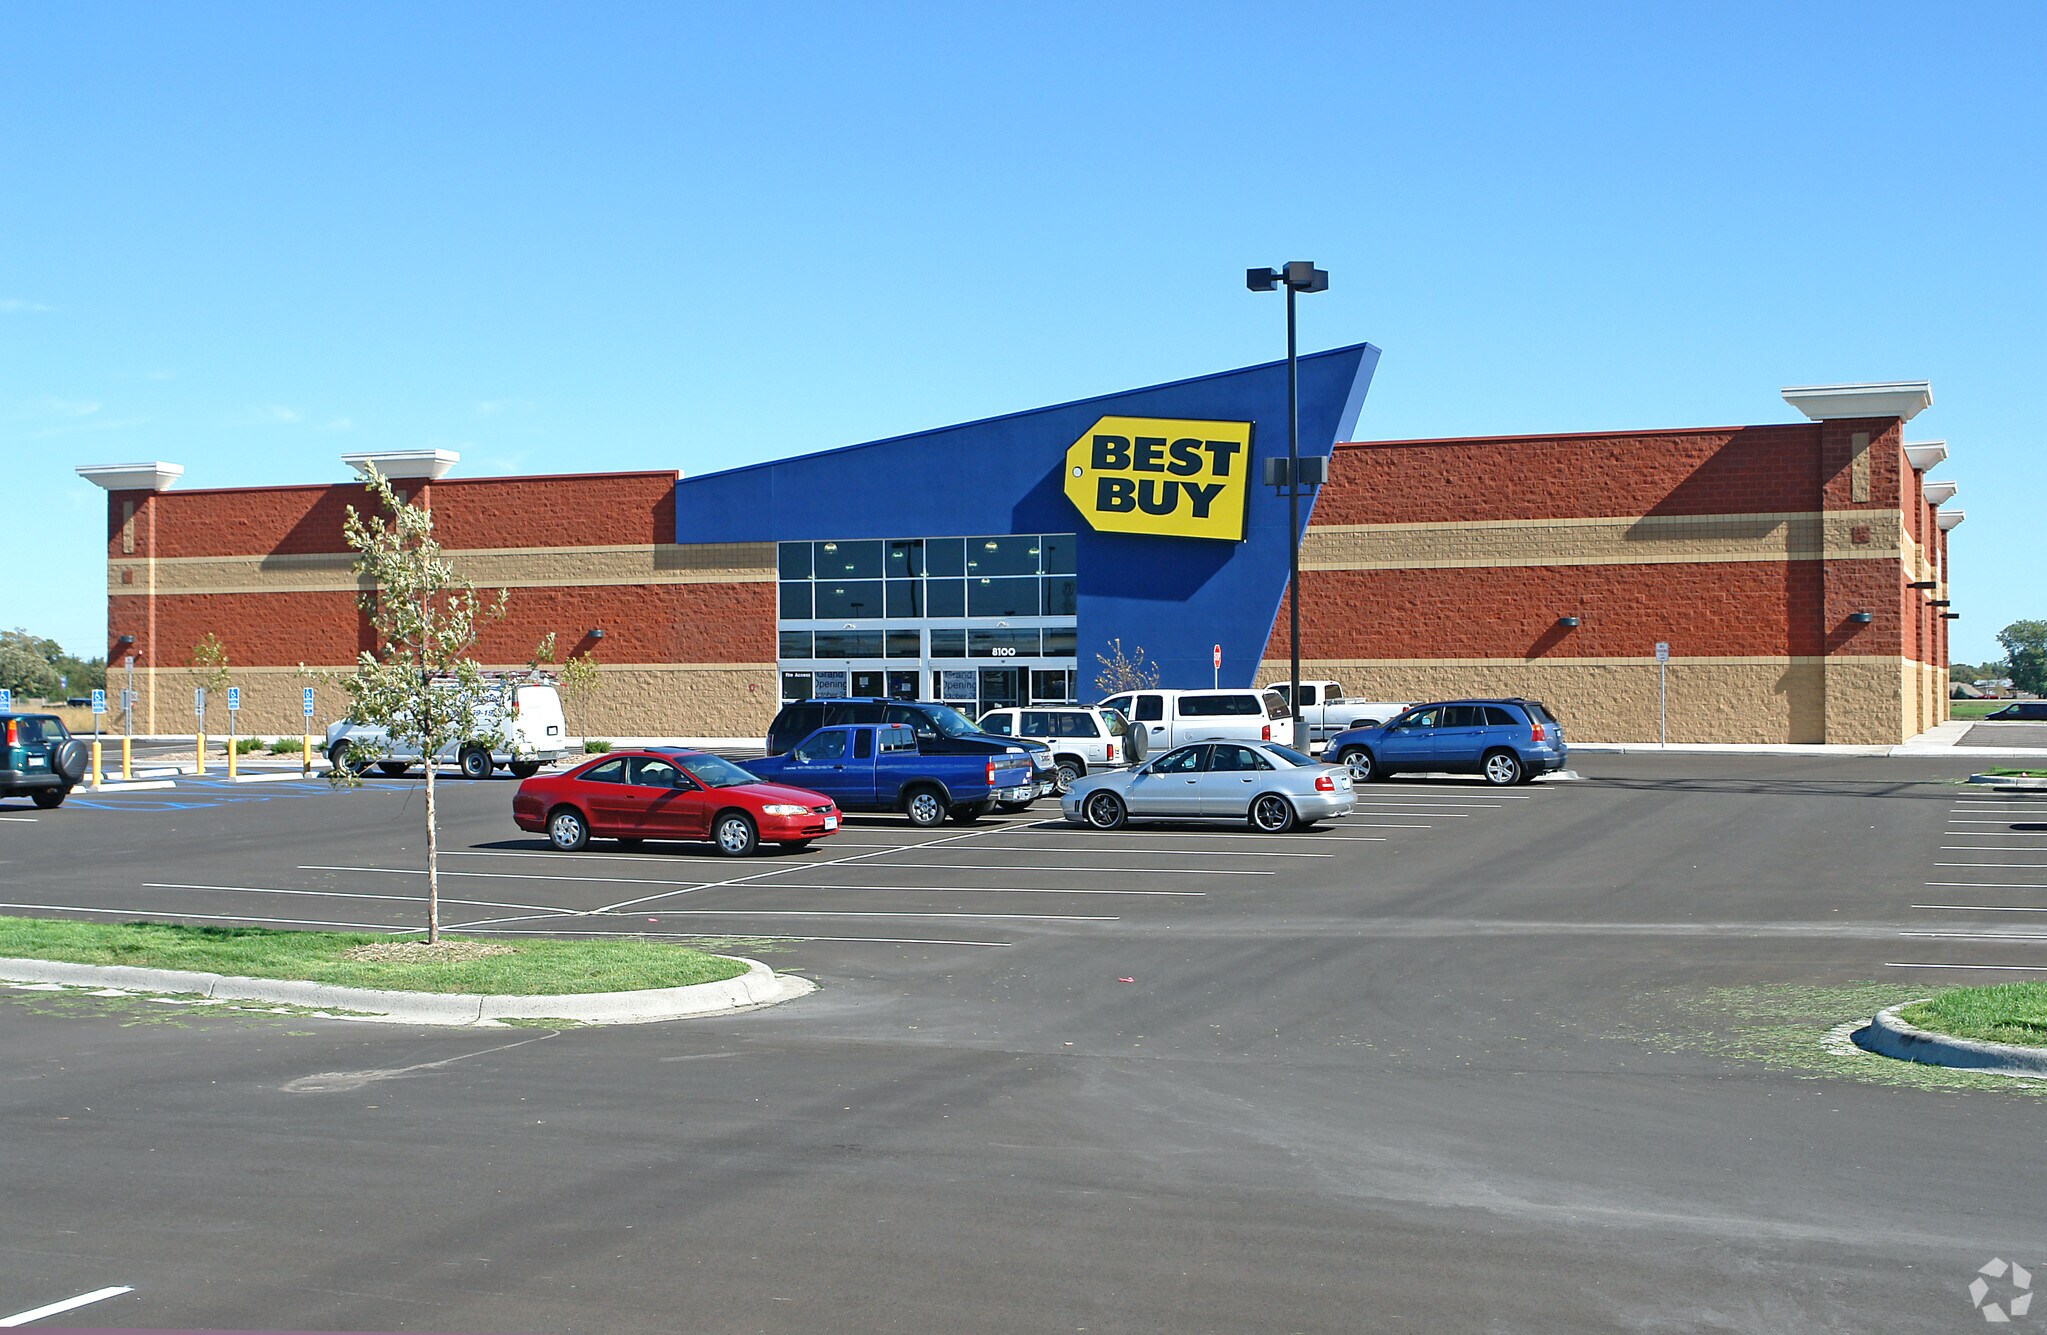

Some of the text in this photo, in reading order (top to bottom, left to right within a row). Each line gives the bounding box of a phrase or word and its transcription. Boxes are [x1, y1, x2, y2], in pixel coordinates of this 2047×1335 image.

[1091, 435, 1241, 477] BEST
[1096, 477, 1226, 518] BUY
[992, 647, 1016, 656] 8100
[816, 671, 844, 679] Grand
[944, 671, 973, 679] Grand
